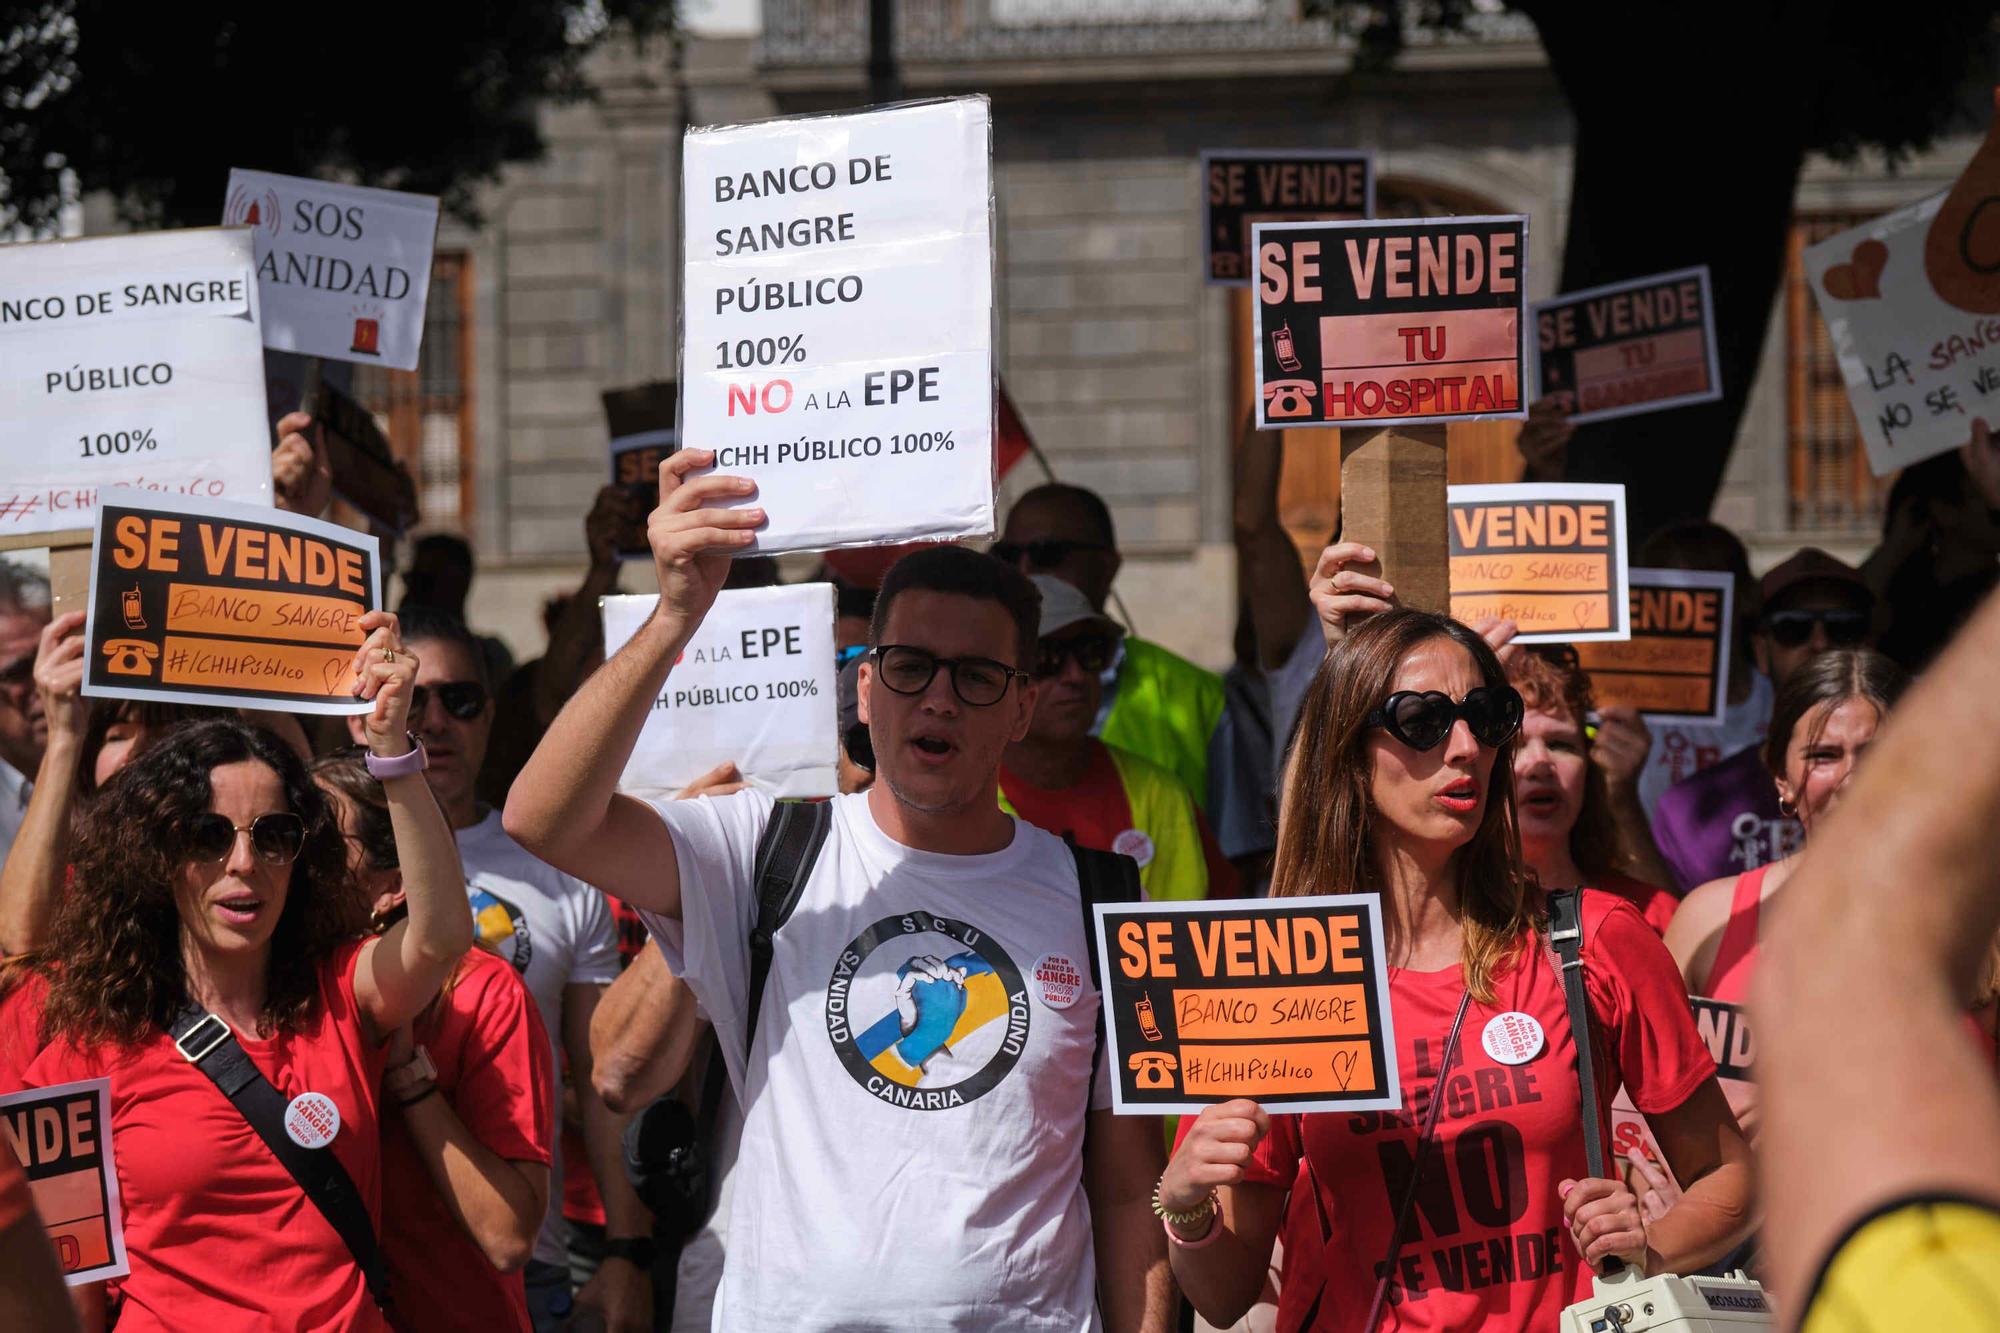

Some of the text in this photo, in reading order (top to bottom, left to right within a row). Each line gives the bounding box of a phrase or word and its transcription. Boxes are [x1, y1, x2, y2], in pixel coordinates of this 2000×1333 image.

[715, 154, 892, 203] BANCO DE
[1209, 163, 1363, 206] SE VENDE
[293, 199, 365, 242] SOS
[715, 212, 856, 257] SANGRE
[257, 249, 410, 301] ANIDAD
[1259, 232, 1517, 305] SE VENDE
[1, 279, 244, 323] NCO DE SANGRE
[715, 275, 863, 315] PÚBLICO
[1539, 282, 1700, 350] SE VENDE
[715, 333, 807, 370] 100%
[1398, 325, 1446, 362] TU
[1619, 342, 1656, 370] TU
[46, 362, 174, 394] PÚBLICO
[727, 367, 940, 417] NO A LA EPE
[1866, 351, 1914, 392] LA
[1323, 374, 1520, 417] HOSPITAL
[1878, 402, 1913, 446] NO
[1925, 384, 1960, 416] SE
[80, 428, 158, 457] 100%
[777, 435, 882, 464] PÚBLICO
[890, 430, 955, 455] 100%
[1452, 504, 1609, 549] VENDE
[113, 515, 366, 598] SE VENDE
[1523, 562, 1599, 582] SANGRE
[171, 589, 356, 634] BANCO SANGRE
[694, 648, 706, 665] A
[711, 646, 732, 662] LA
[740, 626, 803, 660] EPE
[675, 685, 759, 709] PÚBLICO
[765, 678, 819, 701] 100%
[1042, 963, 1065, 972] BANCO
[1118, 914, 1364, 979] SE VENDE
[827, 950, 860, 1044] SANIDAD
[1036, 969, 1081, 986] SANGRE
[1003, 990, 1028, 1056] UNIDA
[1178, 993, 1358, 1028] BANCO SANGRE
[1502, 1015, 1528, 1059] SANGRE
[867, 1075, 965, 1110] CANARIA
[295, 1100, 333, 1140] SANGRE
[1376, 1119, 1529, 1245] NO
[1431, 1227, 1563, 1293] VENDE
[1705, 1295, 1766, 1309] MONACOR
